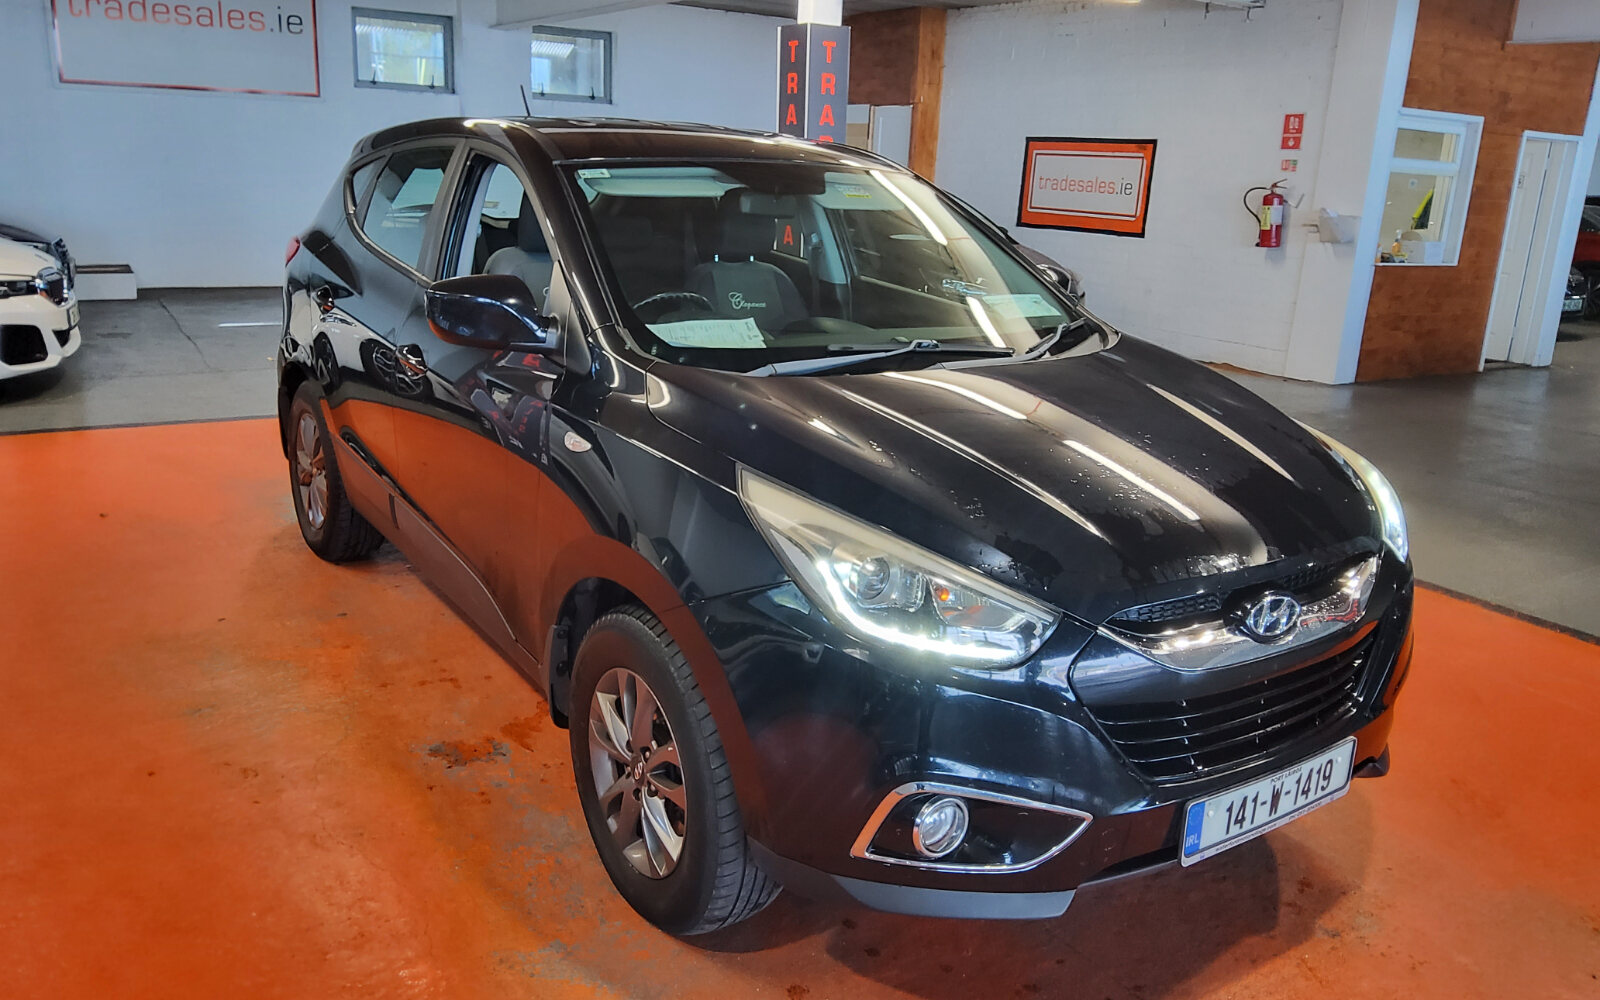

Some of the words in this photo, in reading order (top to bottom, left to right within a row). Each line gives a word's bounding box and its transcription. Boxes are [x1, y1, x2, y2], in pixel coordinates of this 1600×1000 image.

[68, 0, 304, 35] tradesales.ie
[1038, 174, 1133, 196] tradesales.ie
[783, 224, 794, 246] A
[1225, 758, 1334, 836] 141-W-1419
[1185, 833, 1200, 848] IRL
